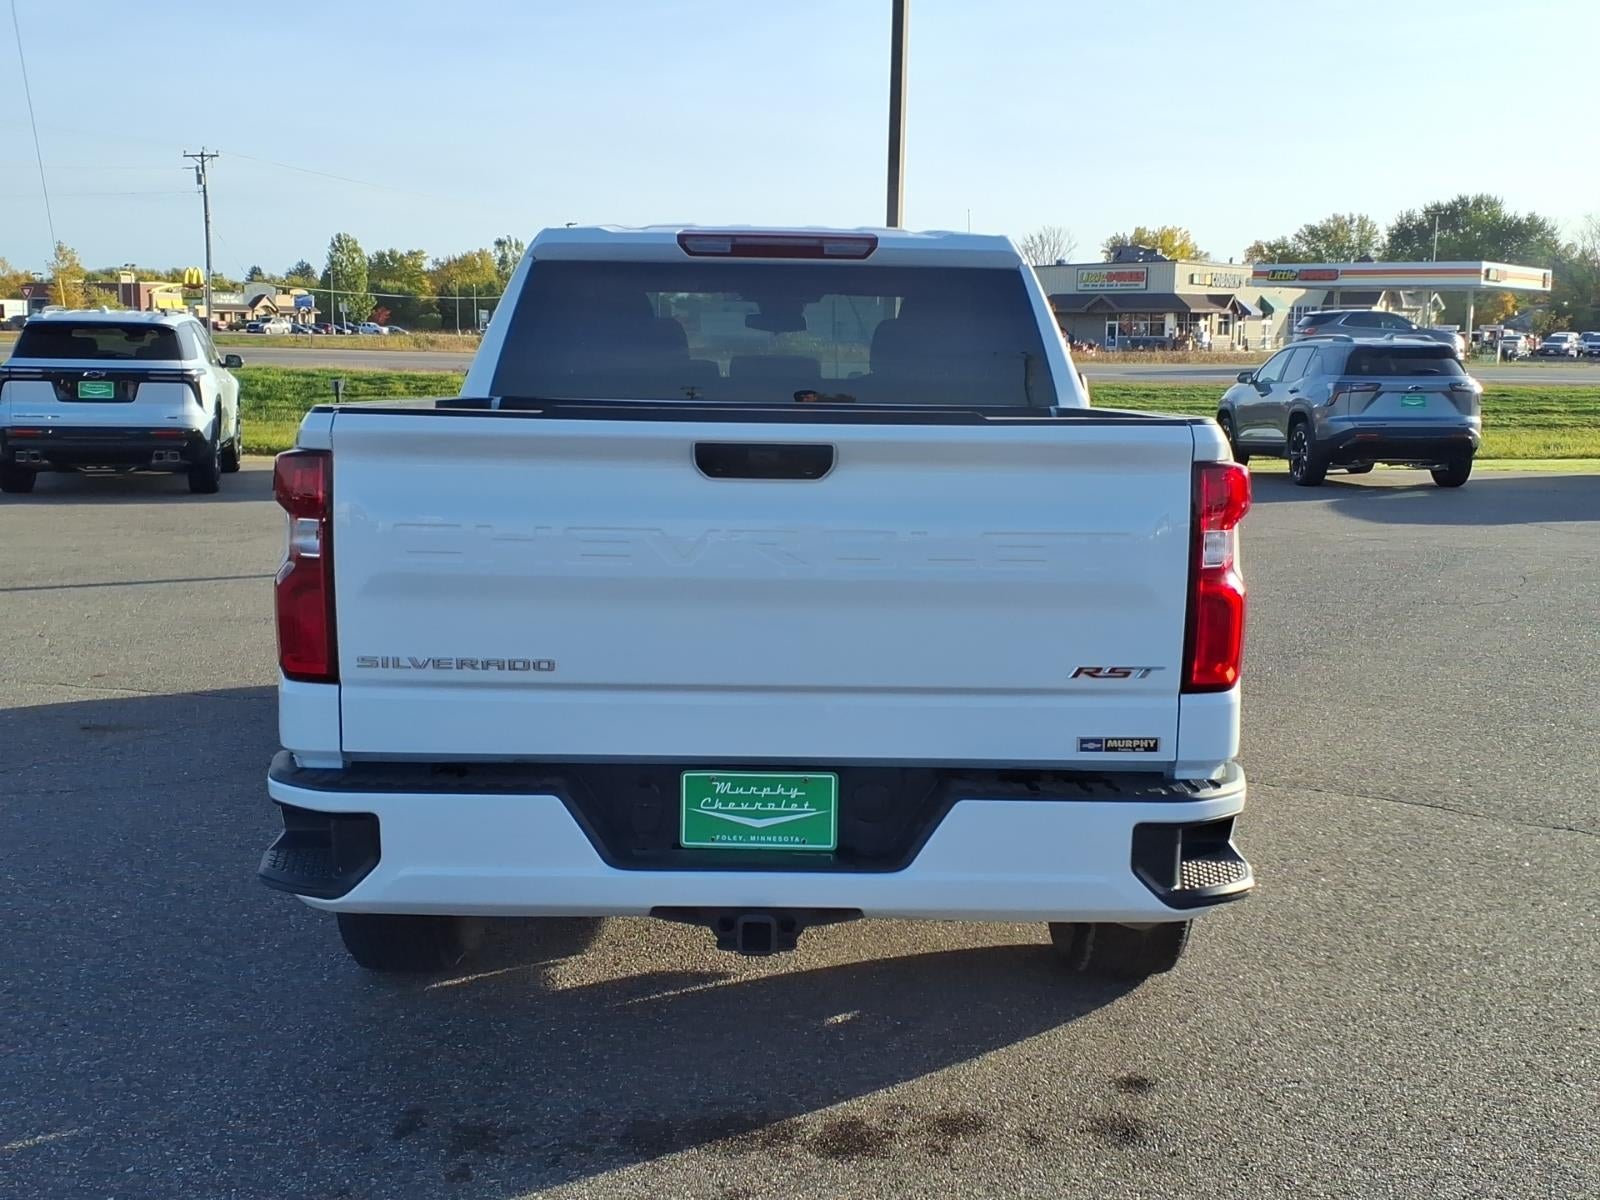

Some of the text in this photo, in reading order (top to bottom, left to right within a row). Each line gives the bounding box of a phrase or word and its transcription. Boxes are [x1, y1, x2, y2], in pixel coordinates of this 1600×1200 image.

[1267, 269, 1297, 281] Little
[356, 656, 556, 672] SILVERADO
[1068, 666, 1166, 679] RST
[1106, 739, 1157, 748] MURPHY
[712, 782, 806, 799] Murphy
[700, 797, 817, 812] Chevrolet
[716, 834, 800, 843] FOLEY, MINNESOTA
